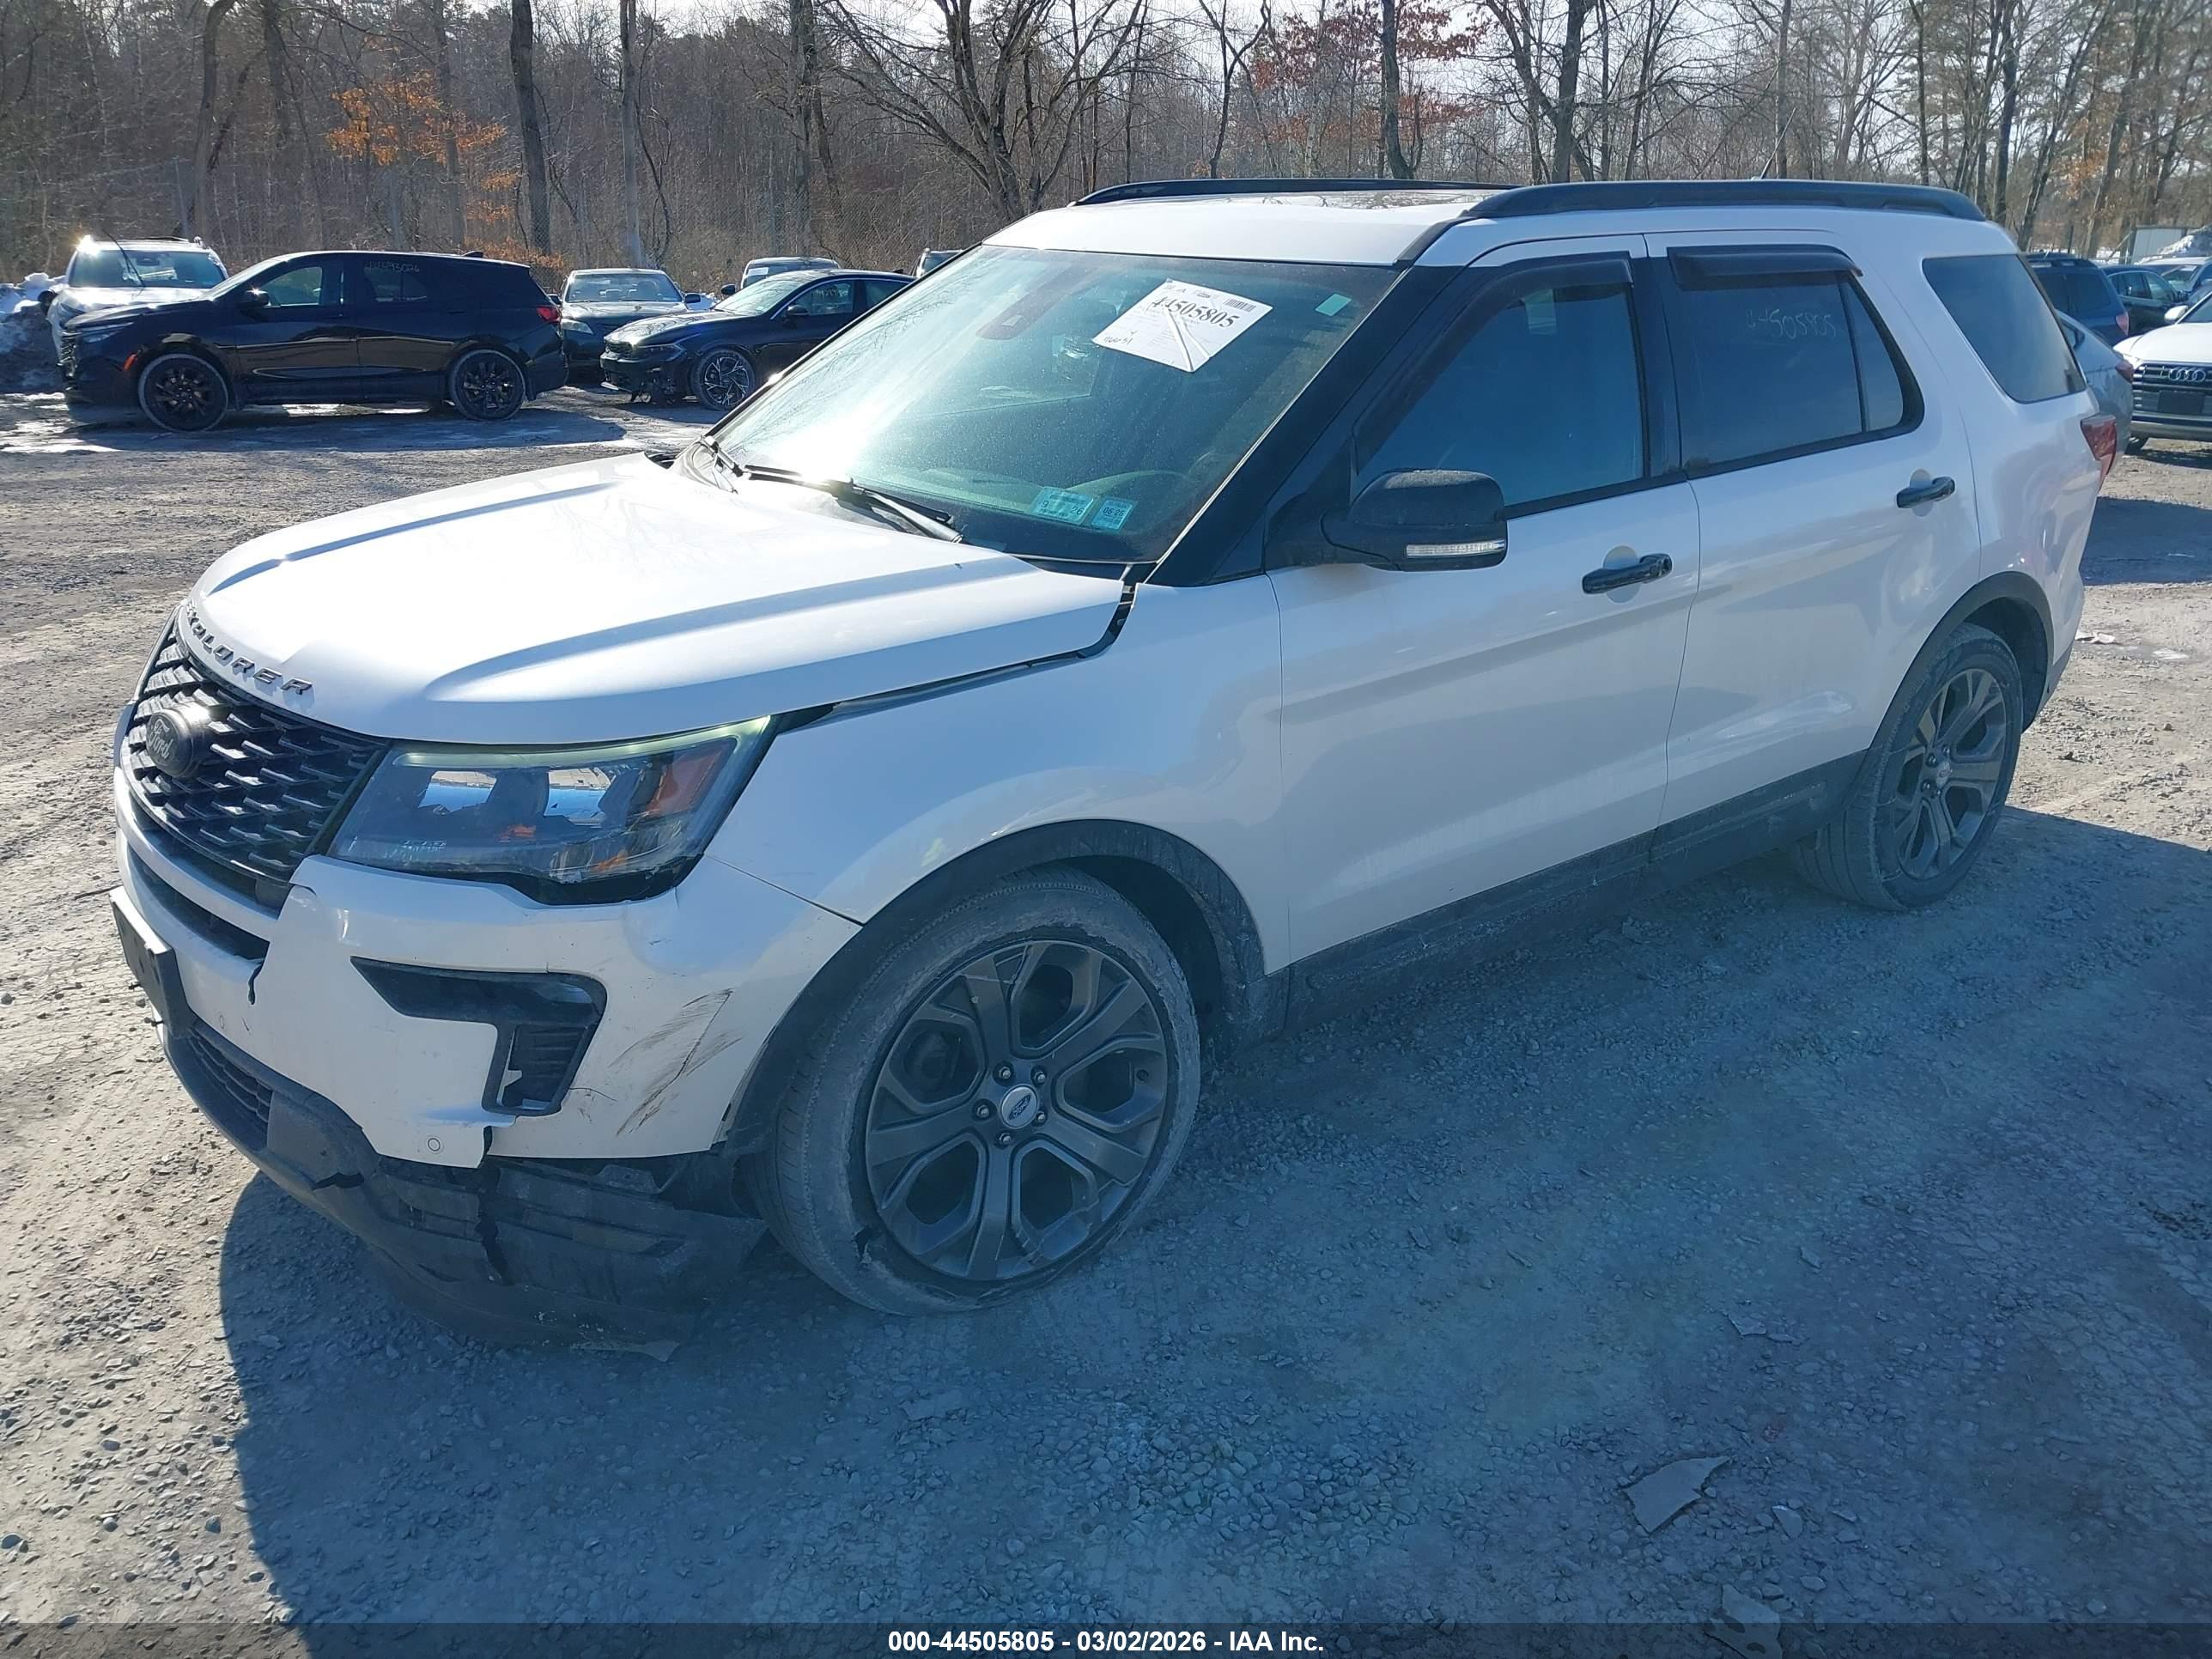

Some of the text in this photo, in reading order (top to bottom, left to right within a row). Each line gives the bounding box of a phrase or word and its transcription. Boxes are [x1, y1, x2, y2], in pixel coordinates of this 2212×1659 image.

[1152, 296, 1240, 328] 44505805
[1070, 506, 1085, 515] 26
[149, 718, 173, 760] Ford
